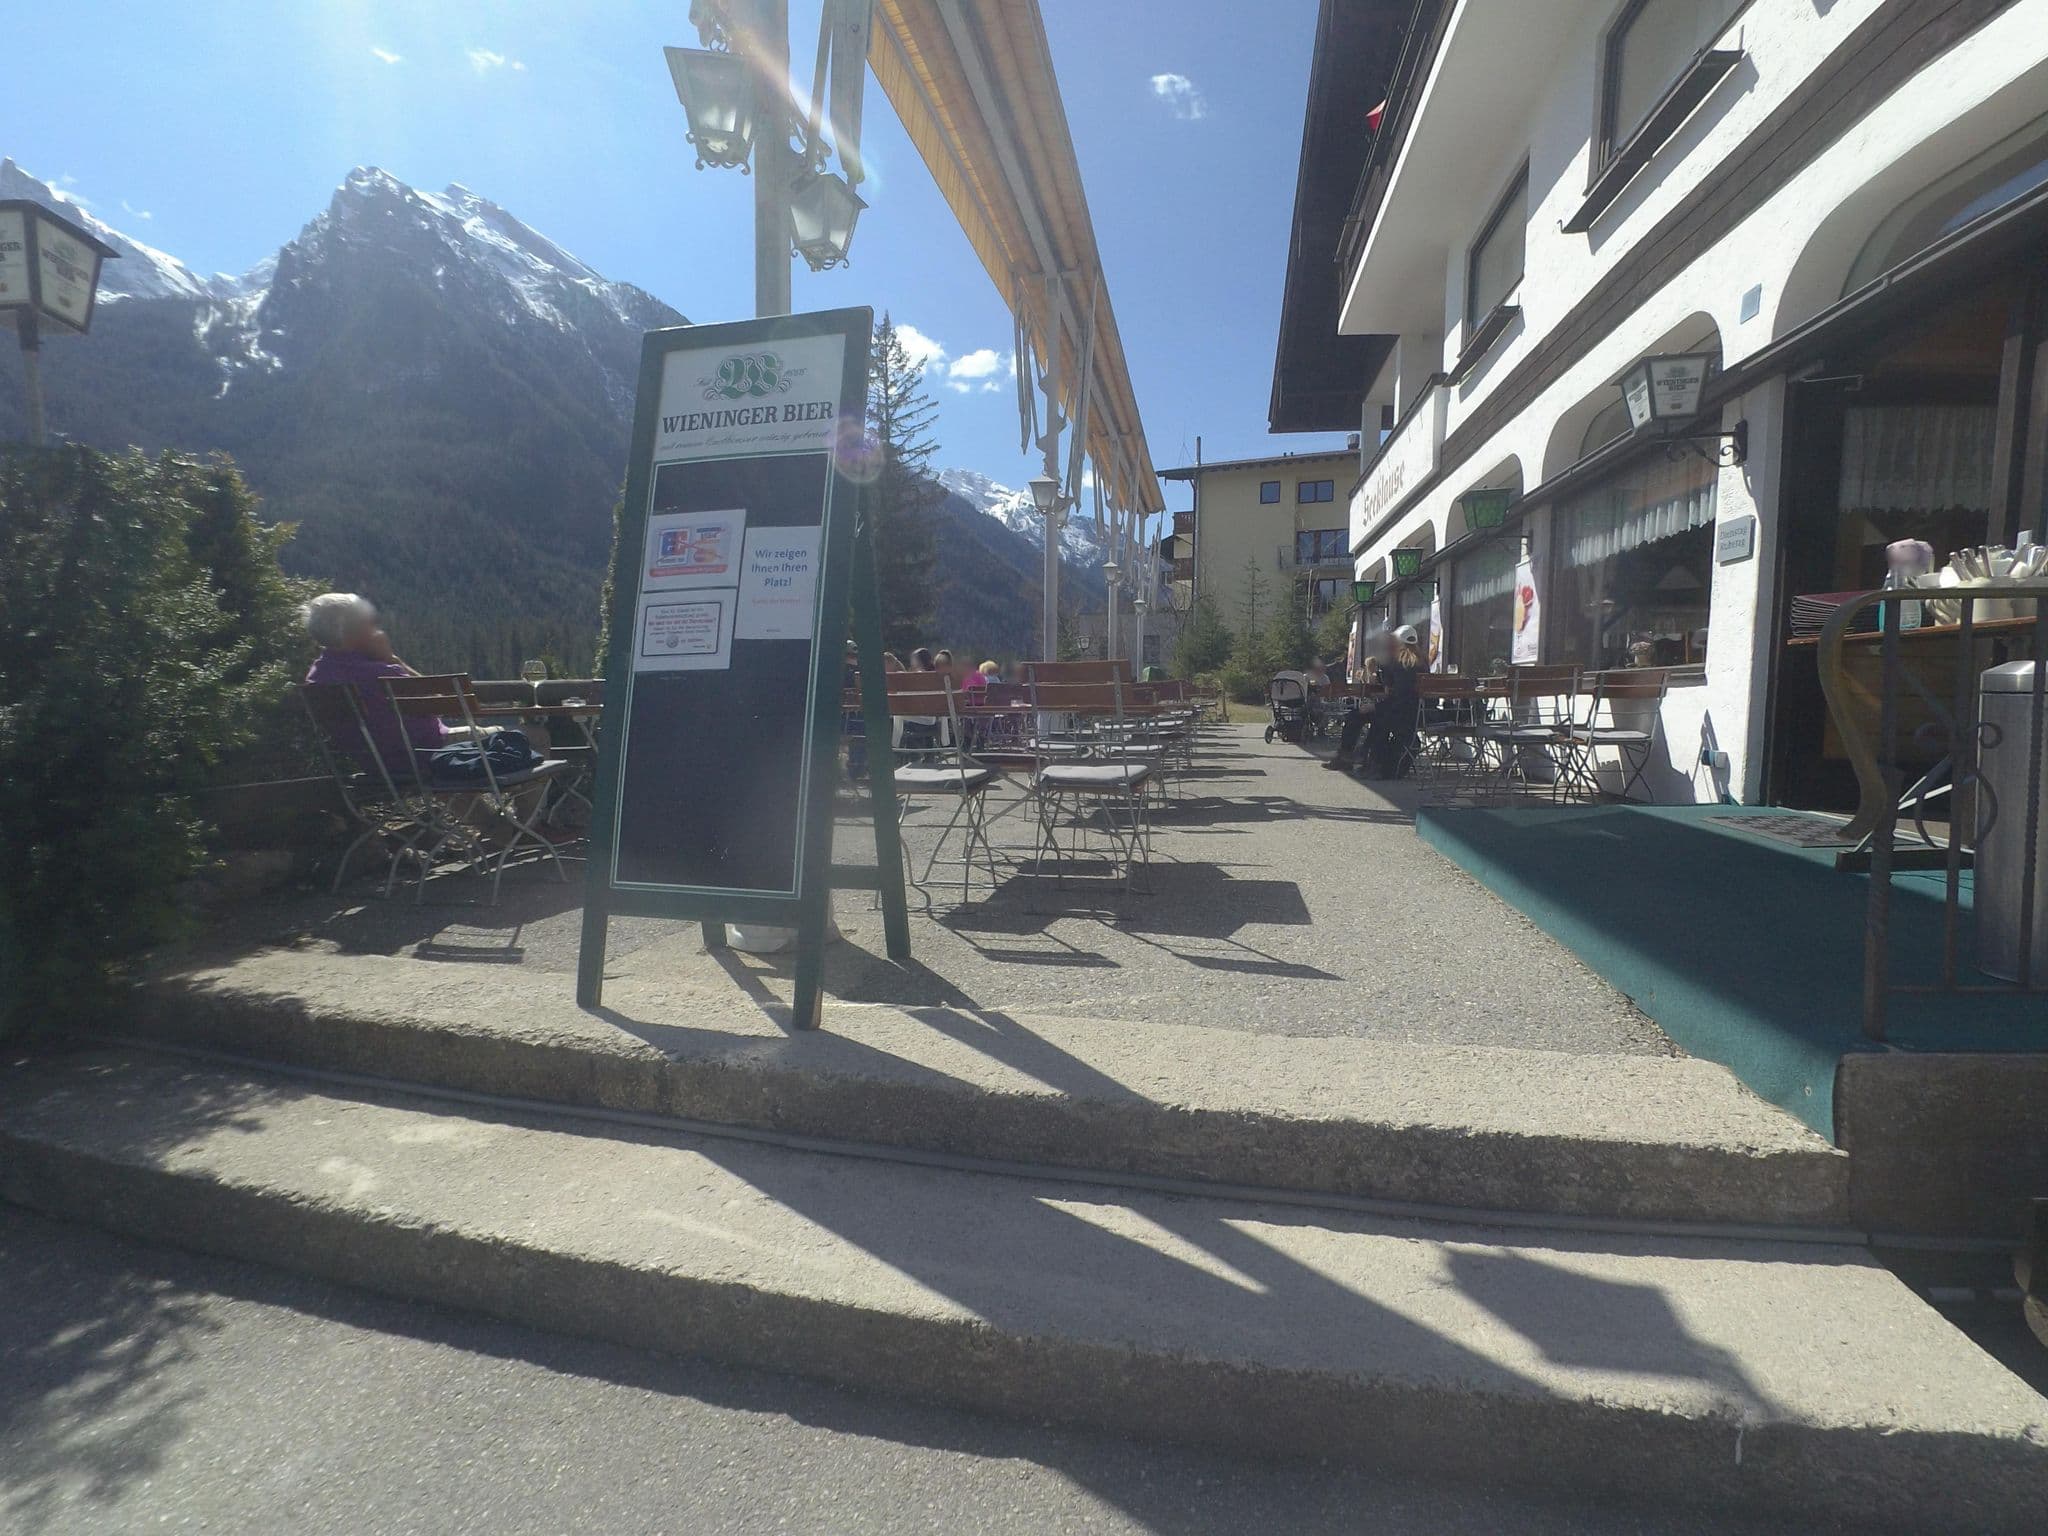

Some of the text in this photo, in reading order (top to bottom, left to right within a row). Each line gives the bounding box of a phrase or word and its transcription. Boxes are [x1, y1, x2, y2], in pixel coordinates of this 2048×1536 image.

[662, 401, 834, 433] WIENINGER BIER
[755, 549, 807, 561] Wir zeigen
[751, 563, 808, 573] Ihnen Ihren
[764, 577, 792, 588] Platz!
